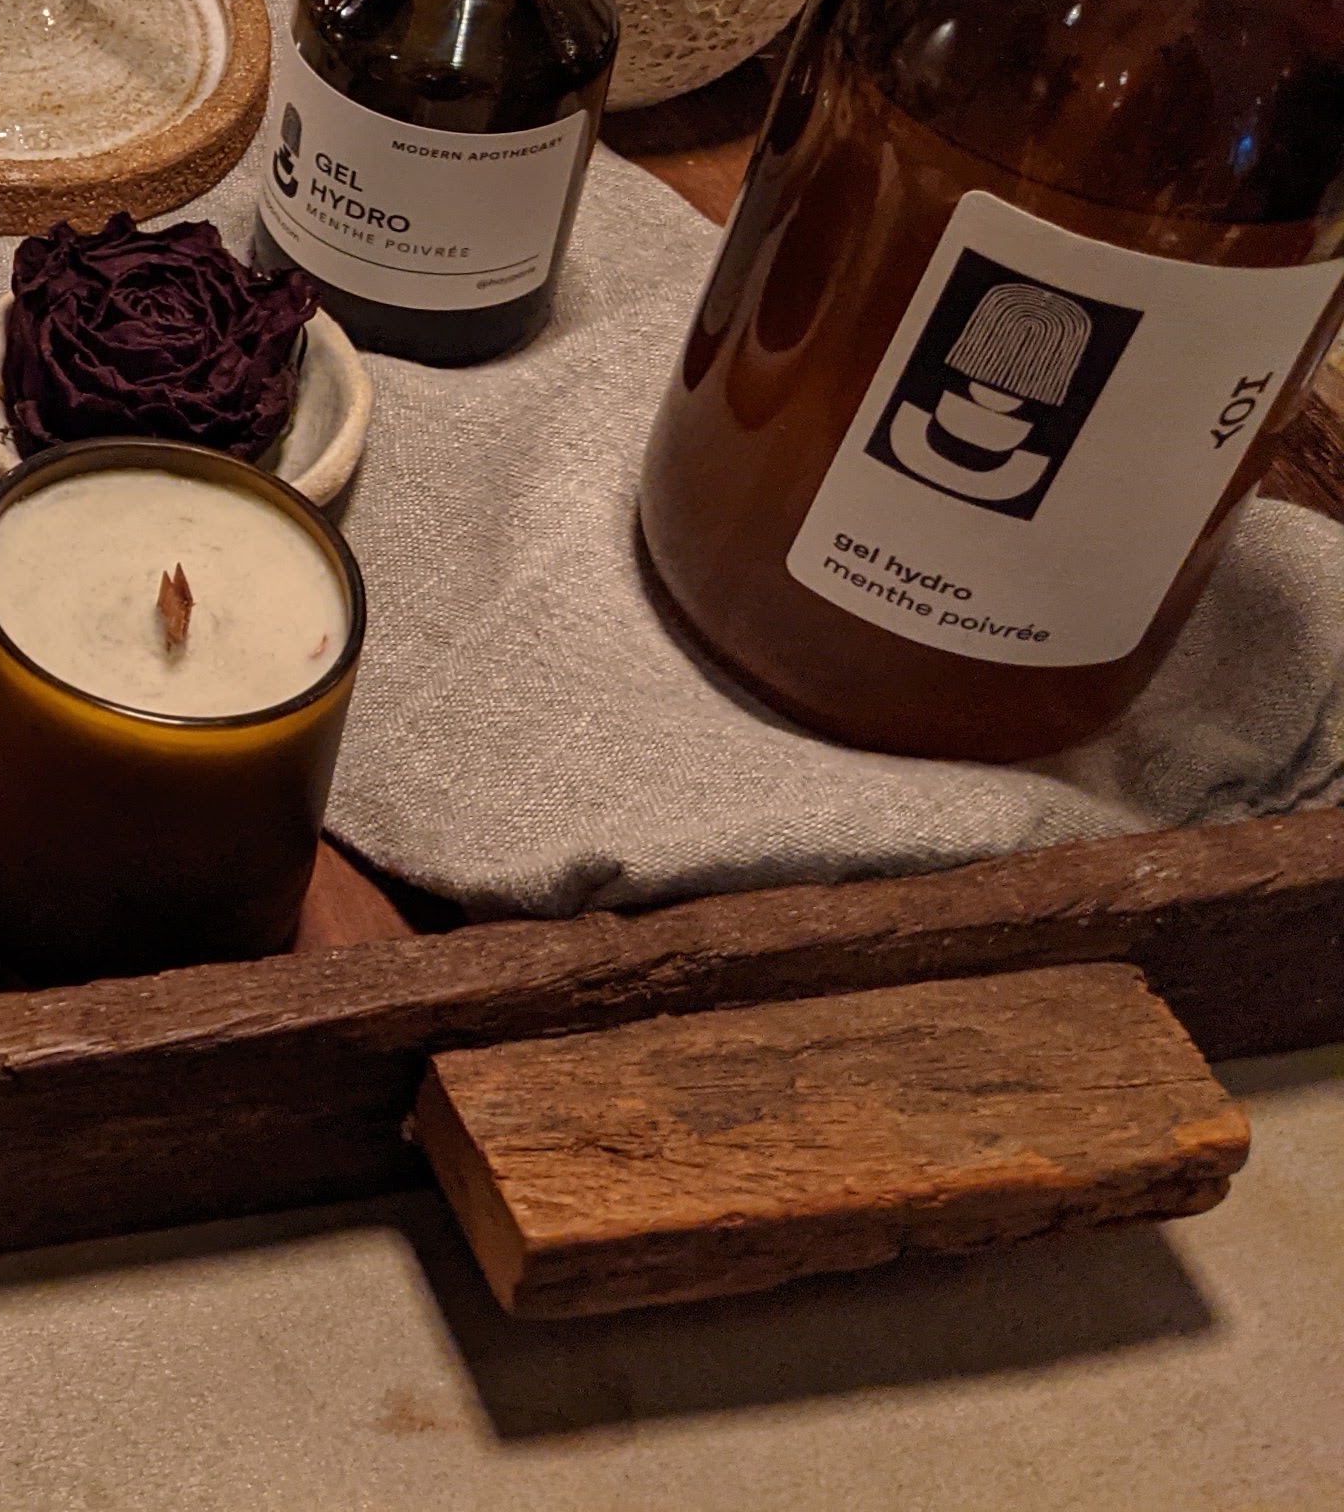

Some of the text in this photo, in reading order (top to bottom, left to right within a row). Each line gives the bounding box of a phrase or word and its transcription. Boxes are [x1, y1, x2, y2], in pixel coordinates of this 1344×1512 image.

[315, 152, 363, 192] GEL
[391, 140, 463, 161] MODERN
[305, 203, 374, 245] MENTHE
[384, 239, 471, 258] POIVRÉE
[310, 178, 410, 233] HYDRO
[1212, 370, 1274, 449] YOI
[833, 531, 973, 602] gel hydro
[823, 554, 1050, 644] menthe poivrée
